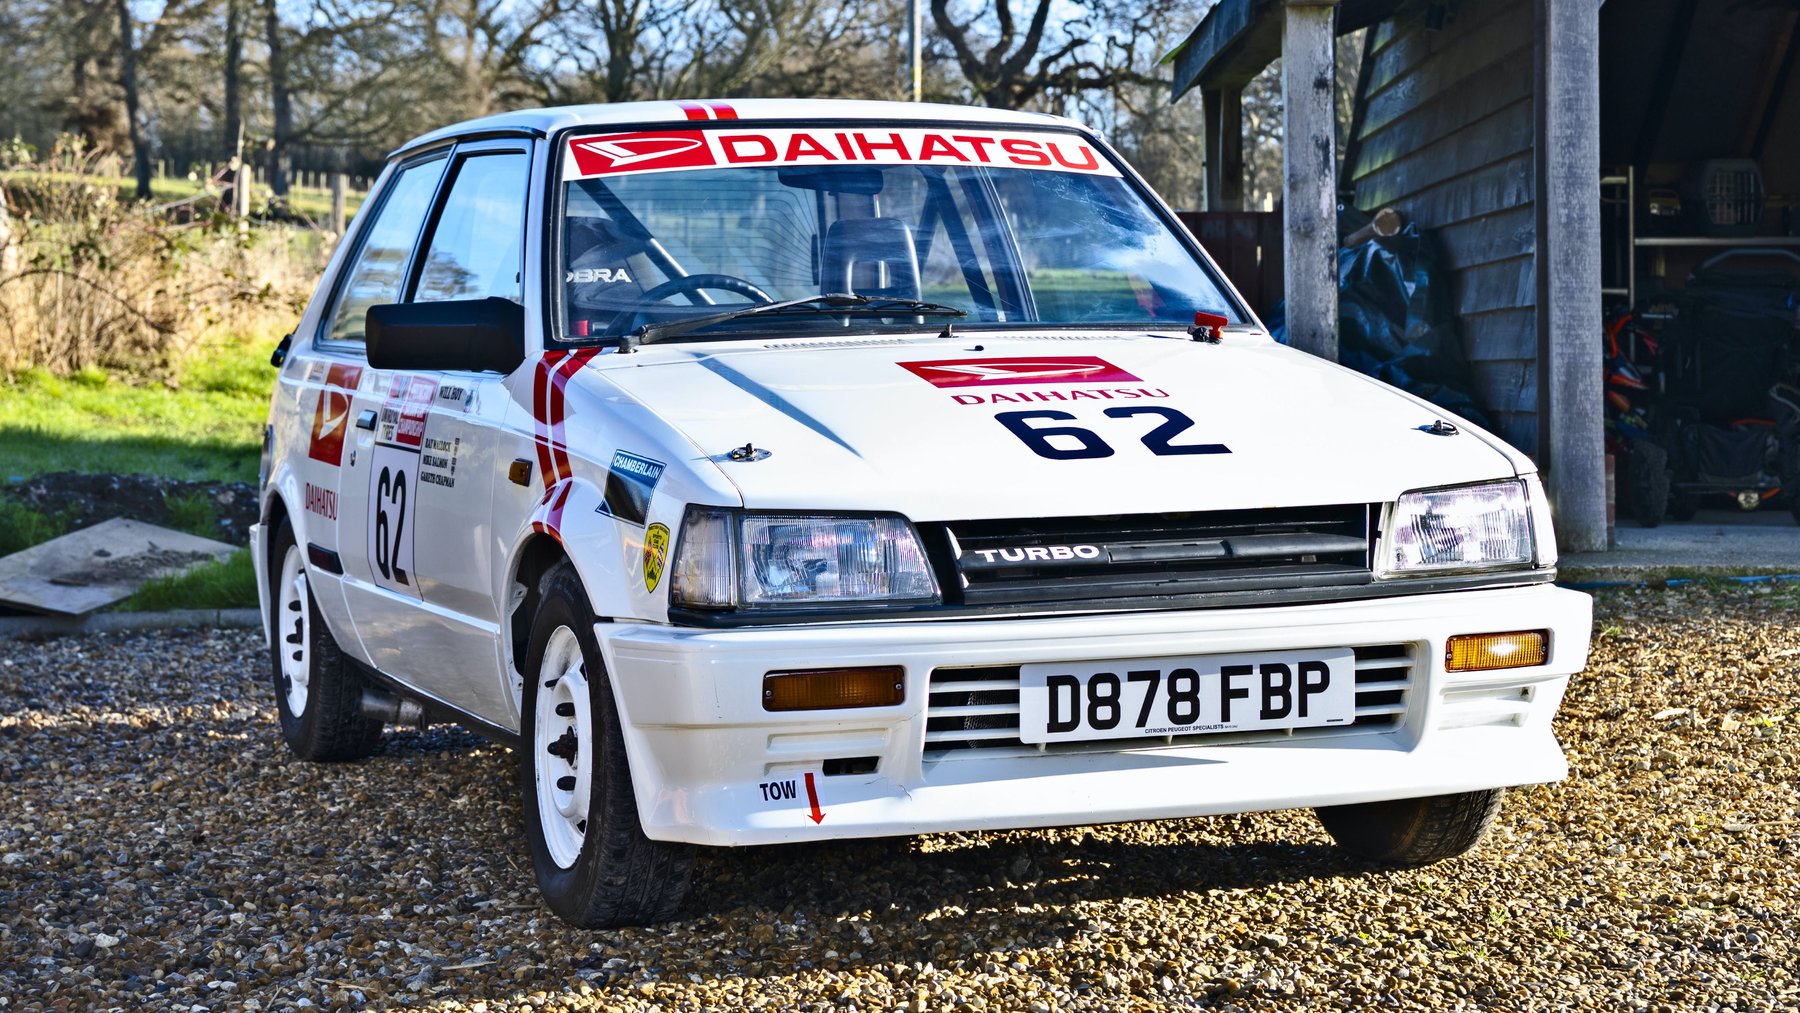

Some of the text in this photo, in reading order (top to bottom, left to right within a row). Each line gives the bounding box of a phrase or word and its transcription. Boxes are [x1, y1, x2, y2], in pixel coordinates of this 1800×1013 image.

[718, 132, 1101, 171] DAIHATSU
[566, 268, 632, 282] BRA
[951, 388, 1170, 405] DAIHATSU
[994, 405, 1233, 460] 62
[614, 455, 661, 478] CHAMBERLAIN
[436, 474, 455, 488] CHAPMAN
[305, 482, 339, 520] DAIHATSU
[376, 466, 410, 586] 62
[974, 545, 1100, 563] TURBO
[1046, 660, 1331, 734] D878 FBP
[759, 780, 796, 801] TOW
